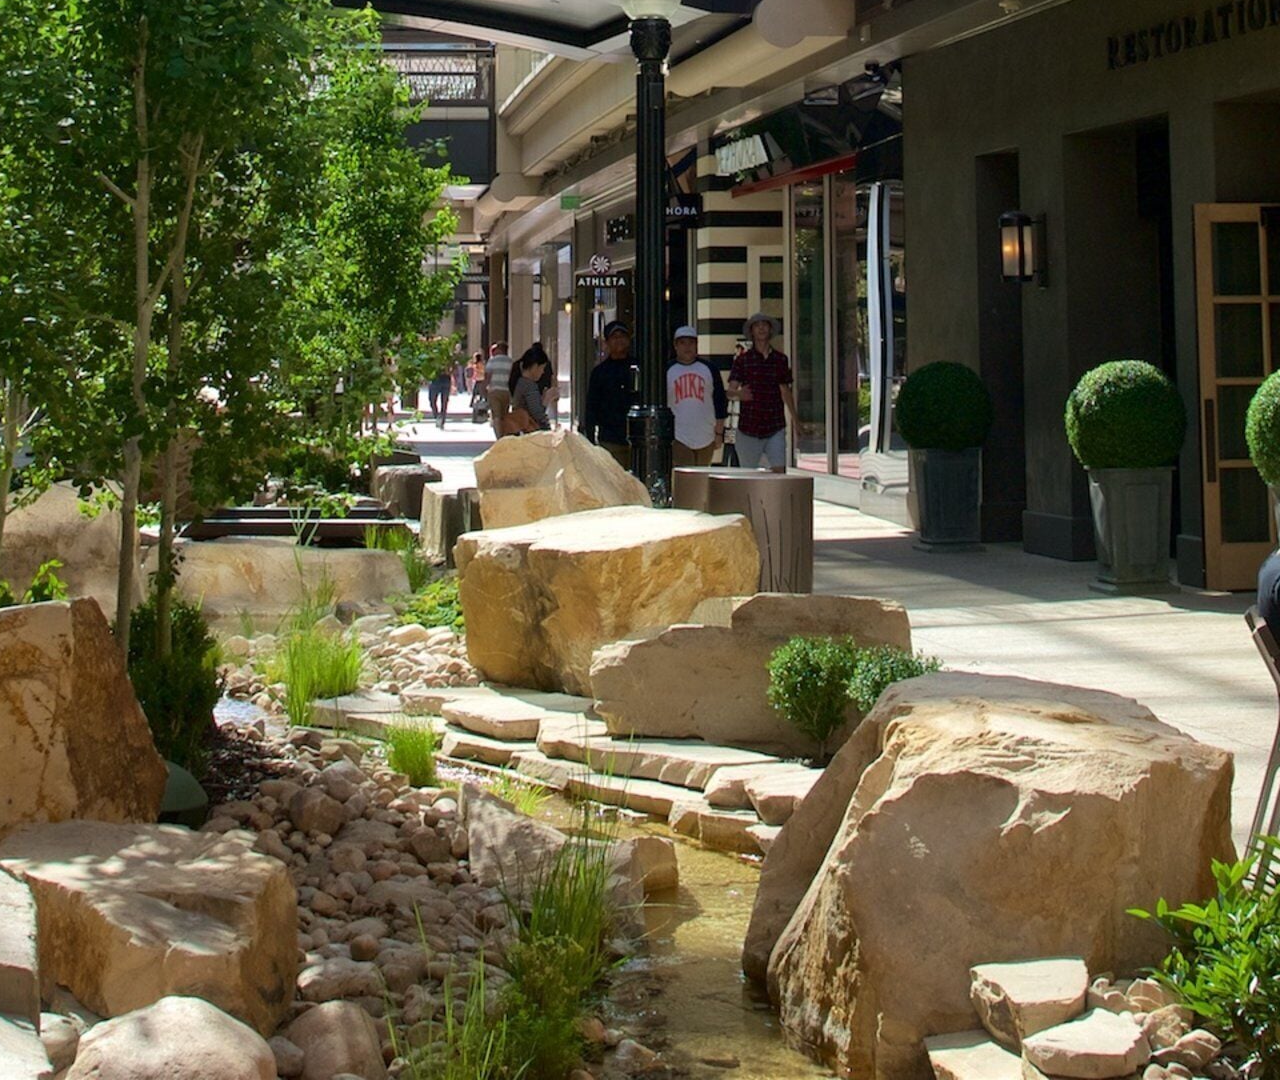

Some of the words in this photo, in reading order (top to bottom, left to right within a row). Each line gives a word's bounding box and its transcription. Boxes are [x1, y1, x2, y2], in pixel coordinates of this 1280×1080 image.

[665, 206, 698, 216] HORA
[577, 277, 626, 286] ATHLETA
[673, 373, 705, 404] NIKE
